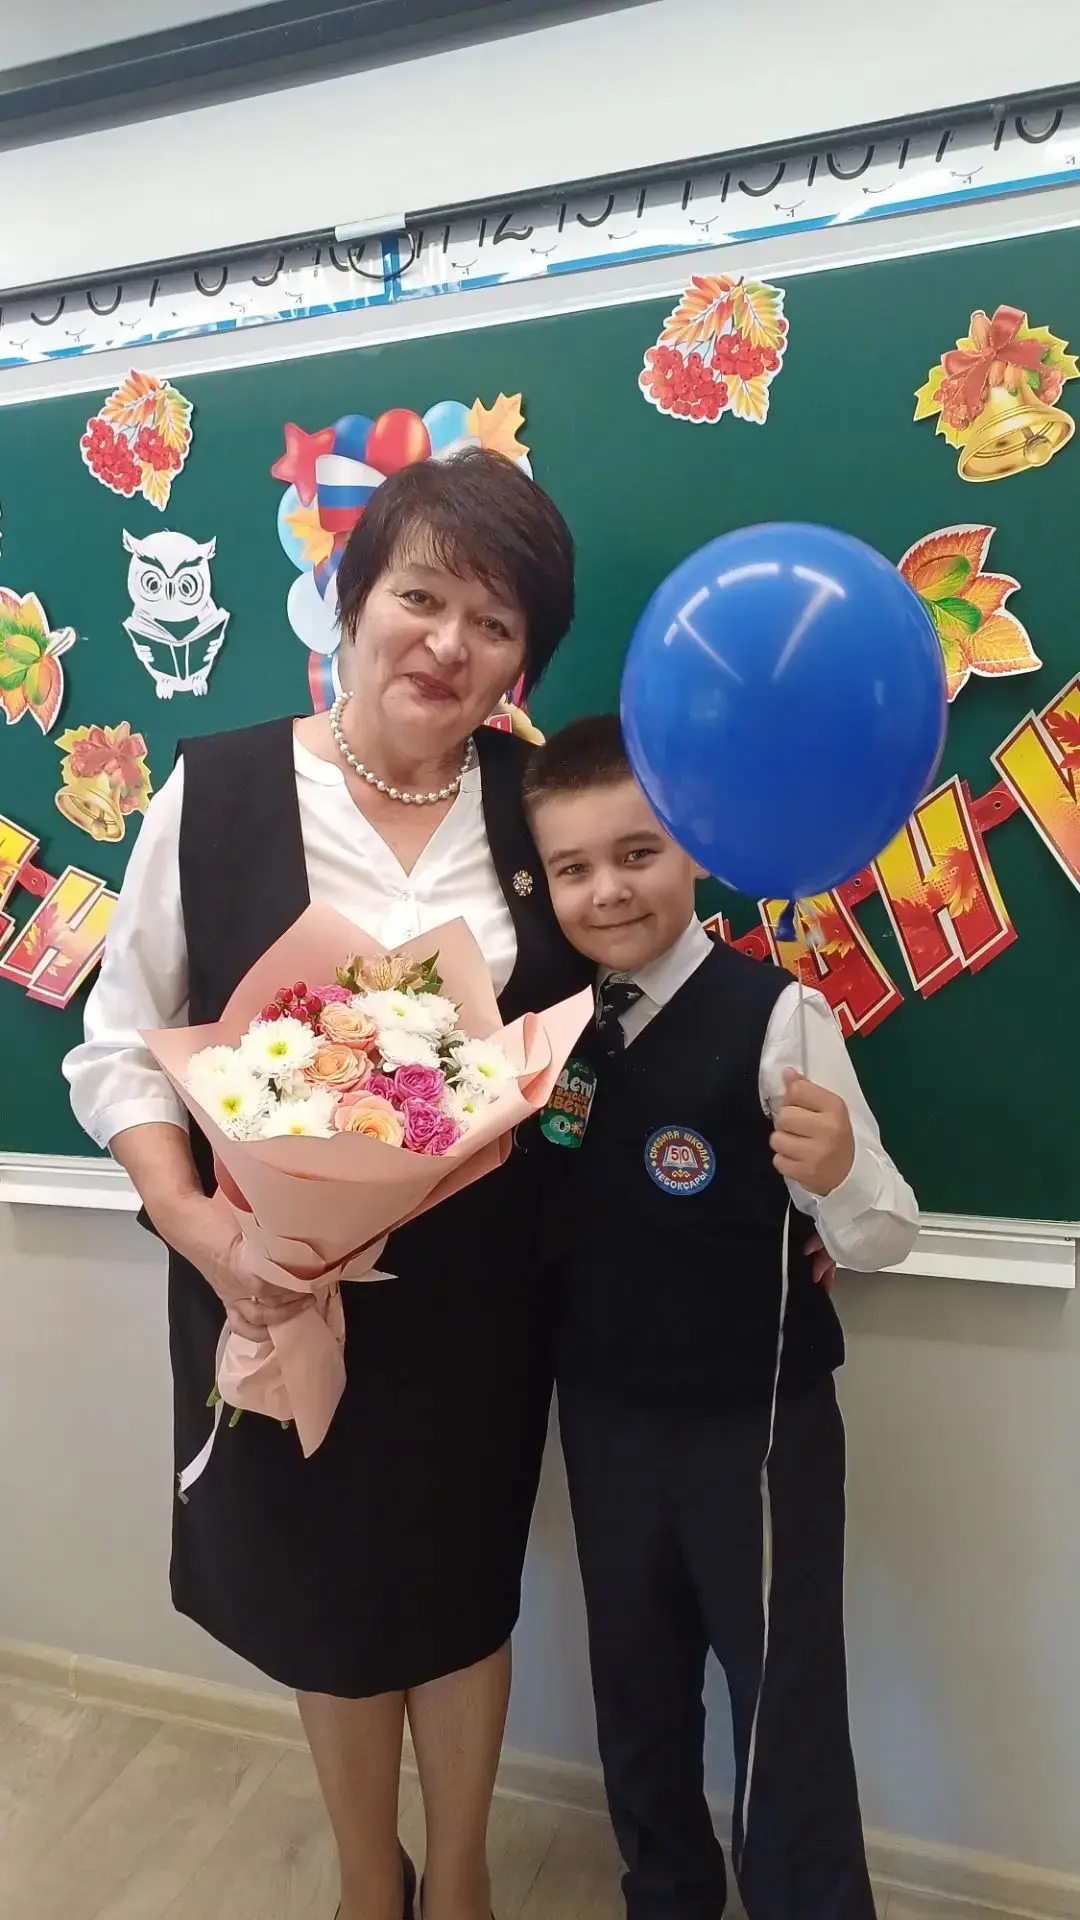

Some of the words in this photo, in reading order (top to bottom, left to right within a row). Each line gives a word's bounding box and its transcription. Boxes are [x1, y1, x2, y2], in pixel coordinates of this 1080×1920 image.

[650, 1130, 680, 1159] СРЕДНЯЯ
[683, 1132, 710, 1163] ШКОЛА
[671, 1147, 690, 1162] 50
[655, 1167, 708, 1190] ЧЕБОКСАРЫ
